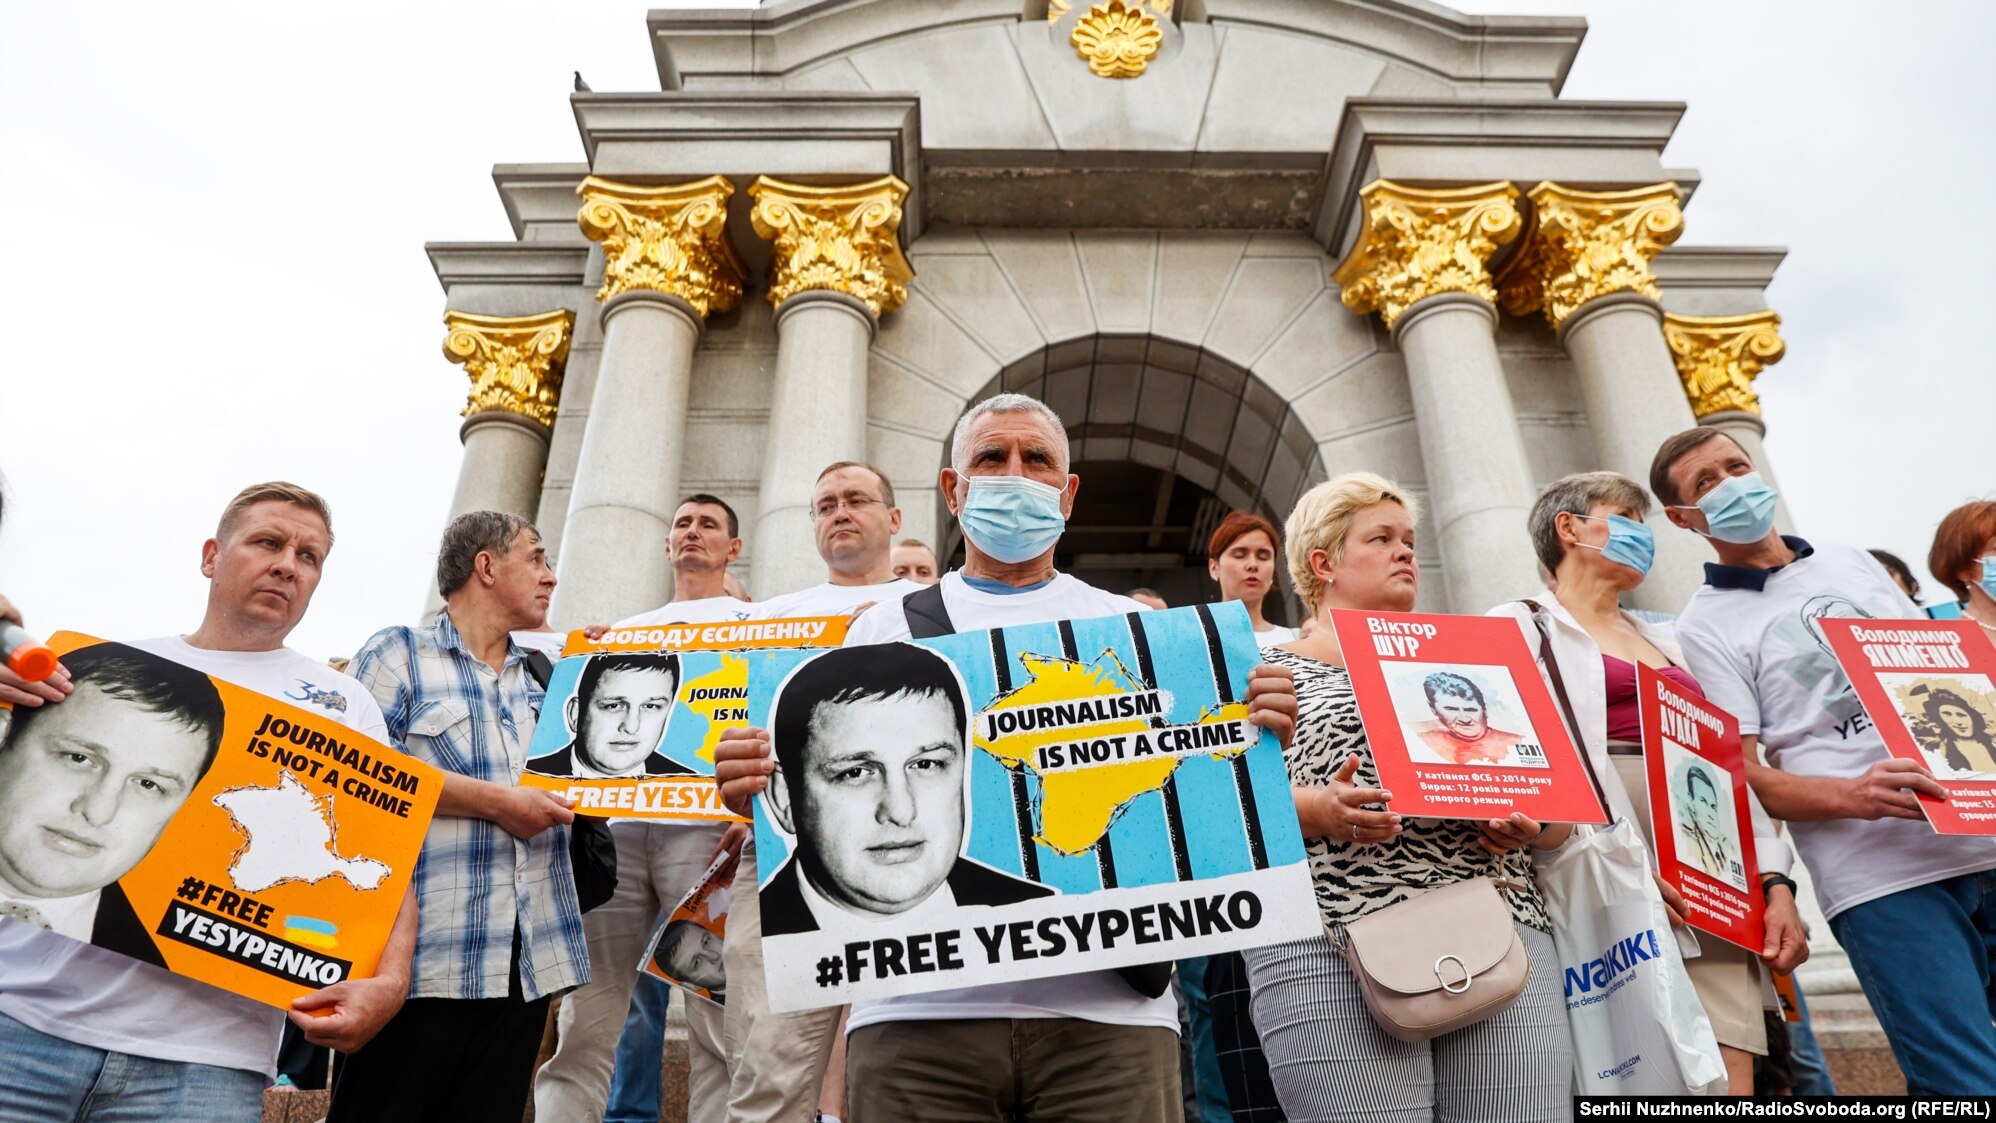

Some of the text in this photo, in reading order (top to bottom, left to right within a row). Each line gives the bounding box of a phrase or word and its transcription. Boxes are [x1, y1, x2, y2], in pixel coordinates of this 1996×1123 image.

[701, 621, 827, 643] ЄСИПЕНКУ
[1366, 617, 1437, 640] Віктор
[1372, 634, 1420, 657] ШУР
[1849, 625, 1961, 646] Володимир
[1862, 644, 1970, 669] ЯКИМЕНКО
[714, 708, 729, 721] IS
[988, 693, 1162, 742] JOURNALISM
[1657, 680, 1724, 738] Володимир
[1660, 704, 1701, 750] ДУДКА
[255, 713, 419, 795] JOURNALISM
[1038, 722, 1245, 769] IS NOT A CRIME
[246, 737, 412, 818] IS NOT A CRIME
[1416, 770, 1422, 778] У
[1425, 772, 1470, 782] катівнях
[1472, 773, 1493, 782] ФСБ
[1502, 774, 1526, 783] 2014
[1528, 776, 1552, 786] року
[1420, 782, 1540, 795] Вирок: 12 років колонії
[1424, 794, 1513, 807] суворого режиму
[177, 876, 275, 928] #FREE
[173, 907, 342, 985] YESYPENKO
[816, 890, 1262, 988] #FREE YESYPENKO
